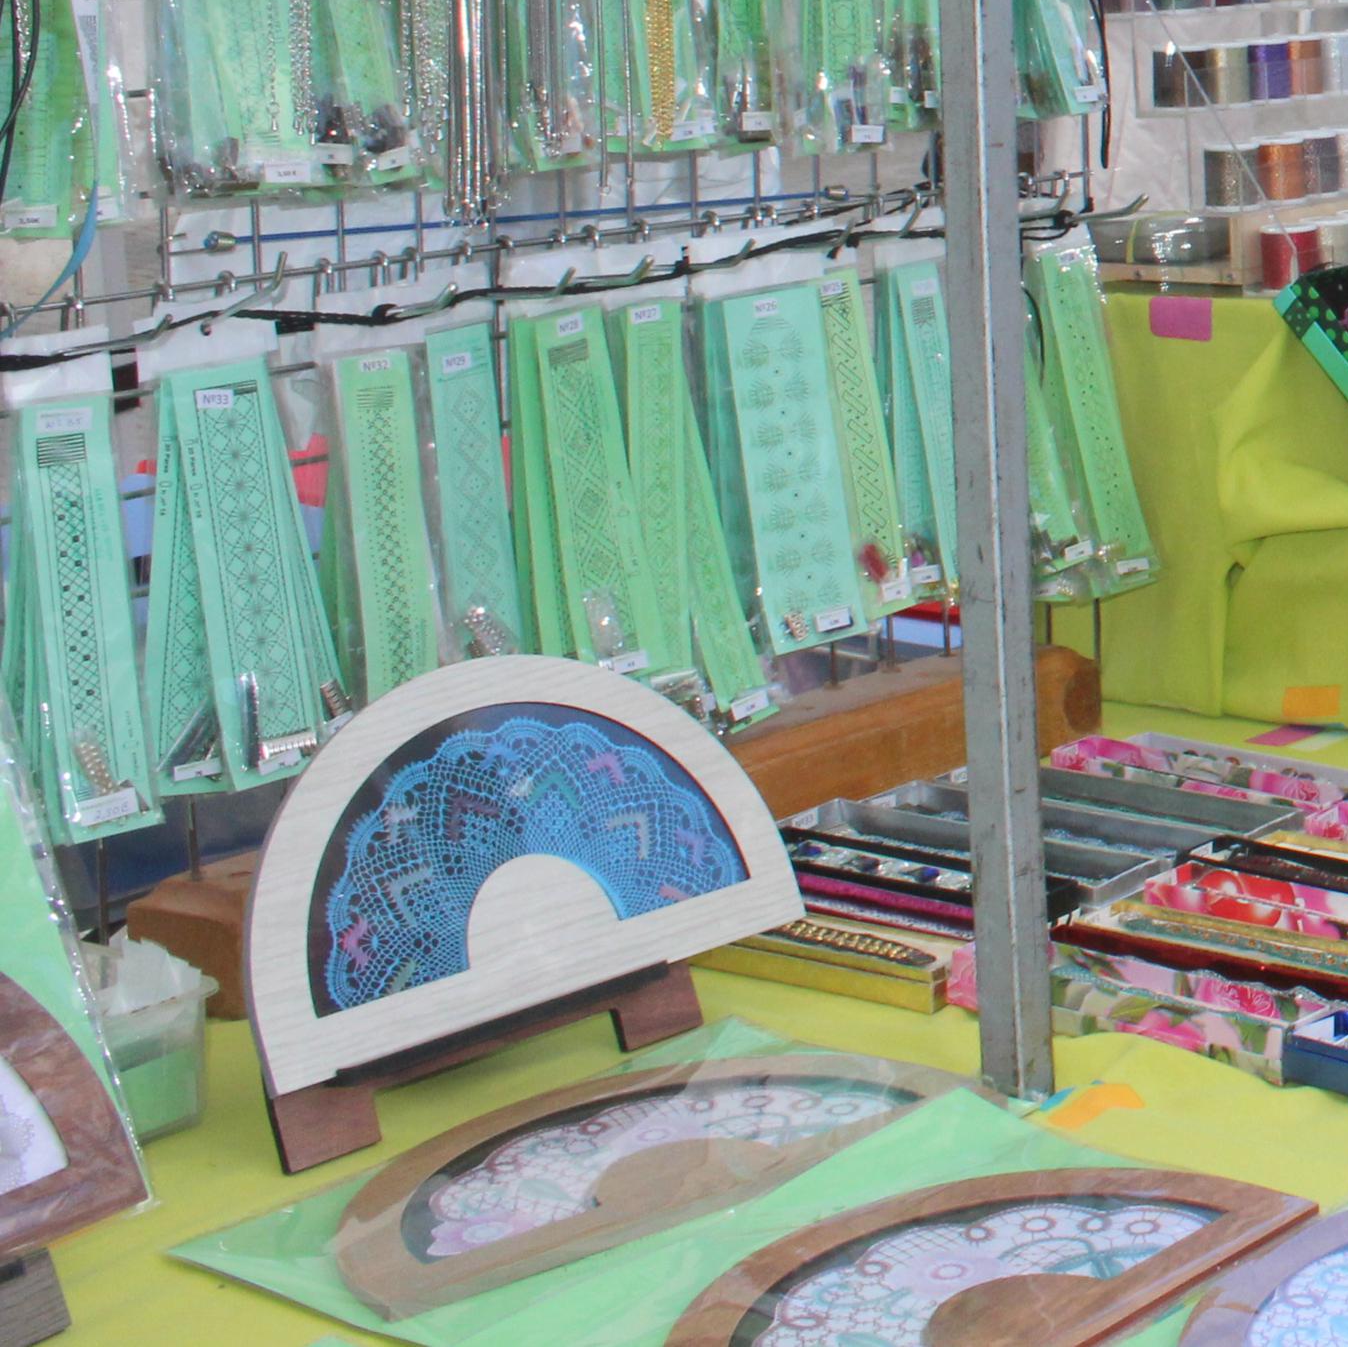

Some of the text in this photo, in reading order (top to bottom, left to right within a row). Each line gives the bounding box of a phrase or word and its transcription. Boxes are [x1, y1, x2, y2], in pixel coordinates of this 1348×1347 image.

[634, 309, 657, 321] Nº27
[559, 321, 579, 333] Nº28
[362, 359, 390, 371] Nº32
[445, 357, 467, 368] Nº29
[202, 393, 230, 406] Nº33
